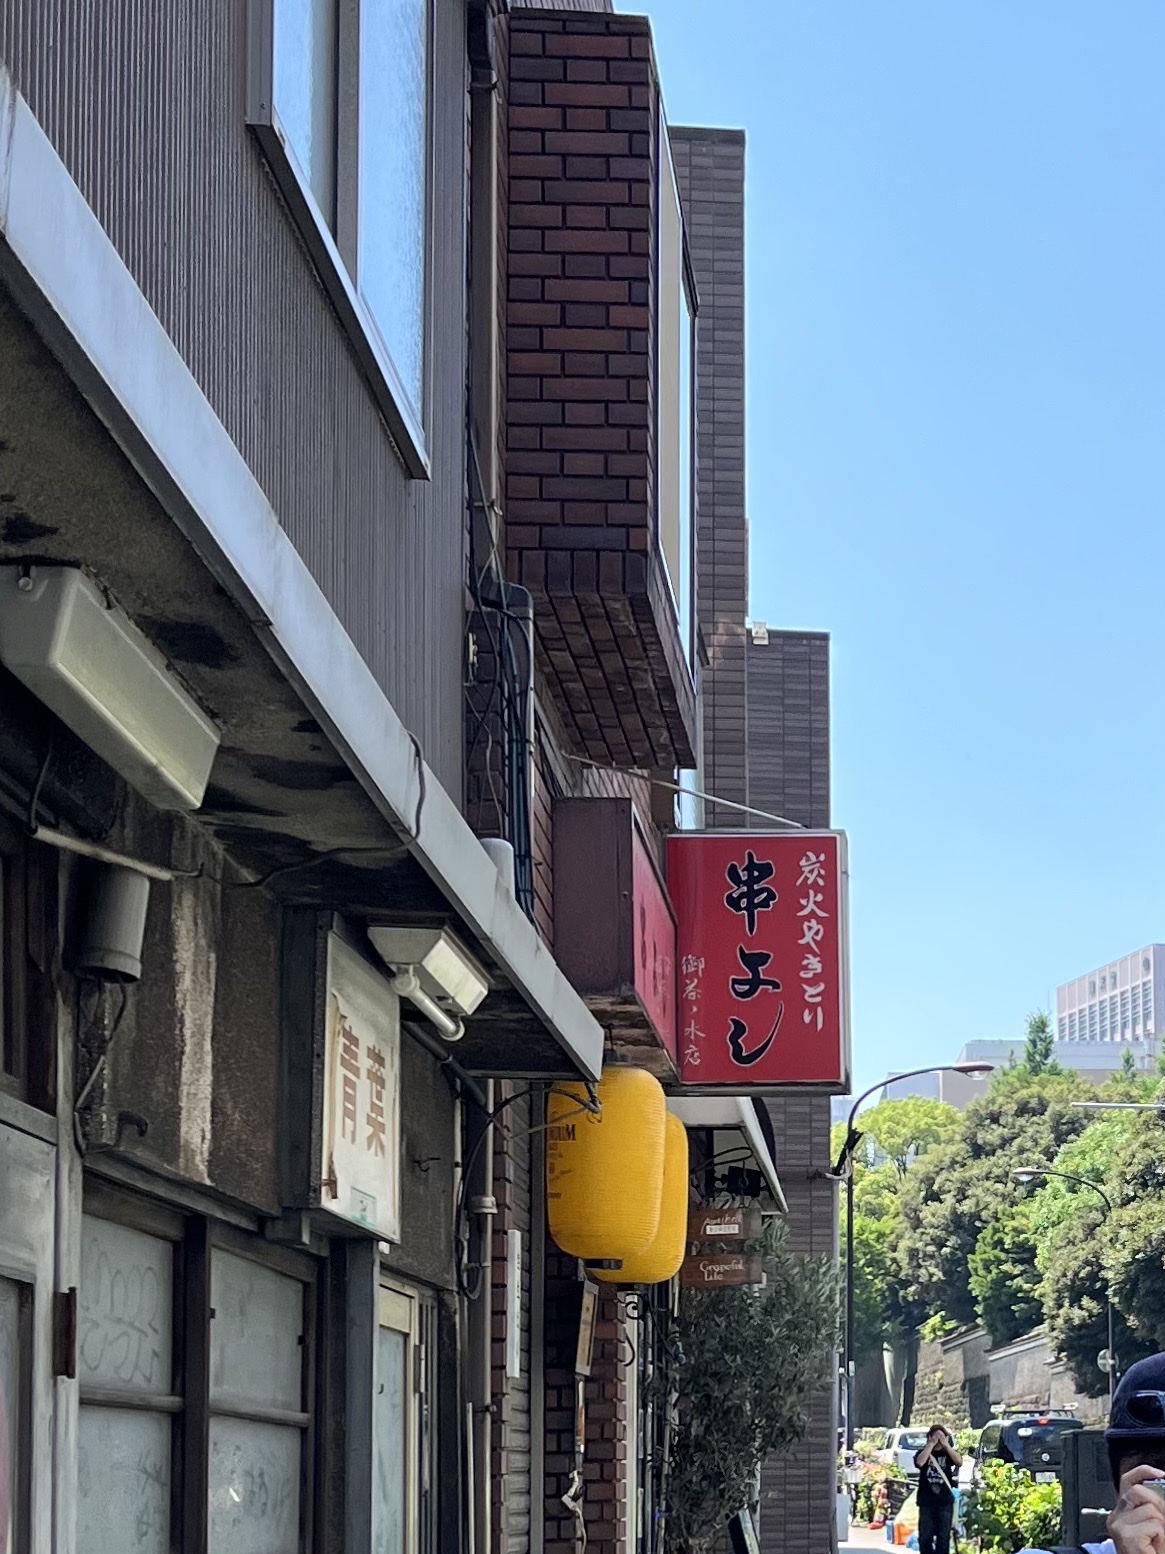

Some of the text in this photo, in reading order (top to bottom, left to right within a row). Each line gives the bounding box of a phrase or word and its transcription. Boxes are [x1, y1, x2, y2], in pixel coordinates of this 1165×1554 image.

[681, 954, 706, 1066] 御茶ノ水店
[724, 849, 783, 1067] 串よし
[796, 851, 829, 1033] 炭火やきとり
